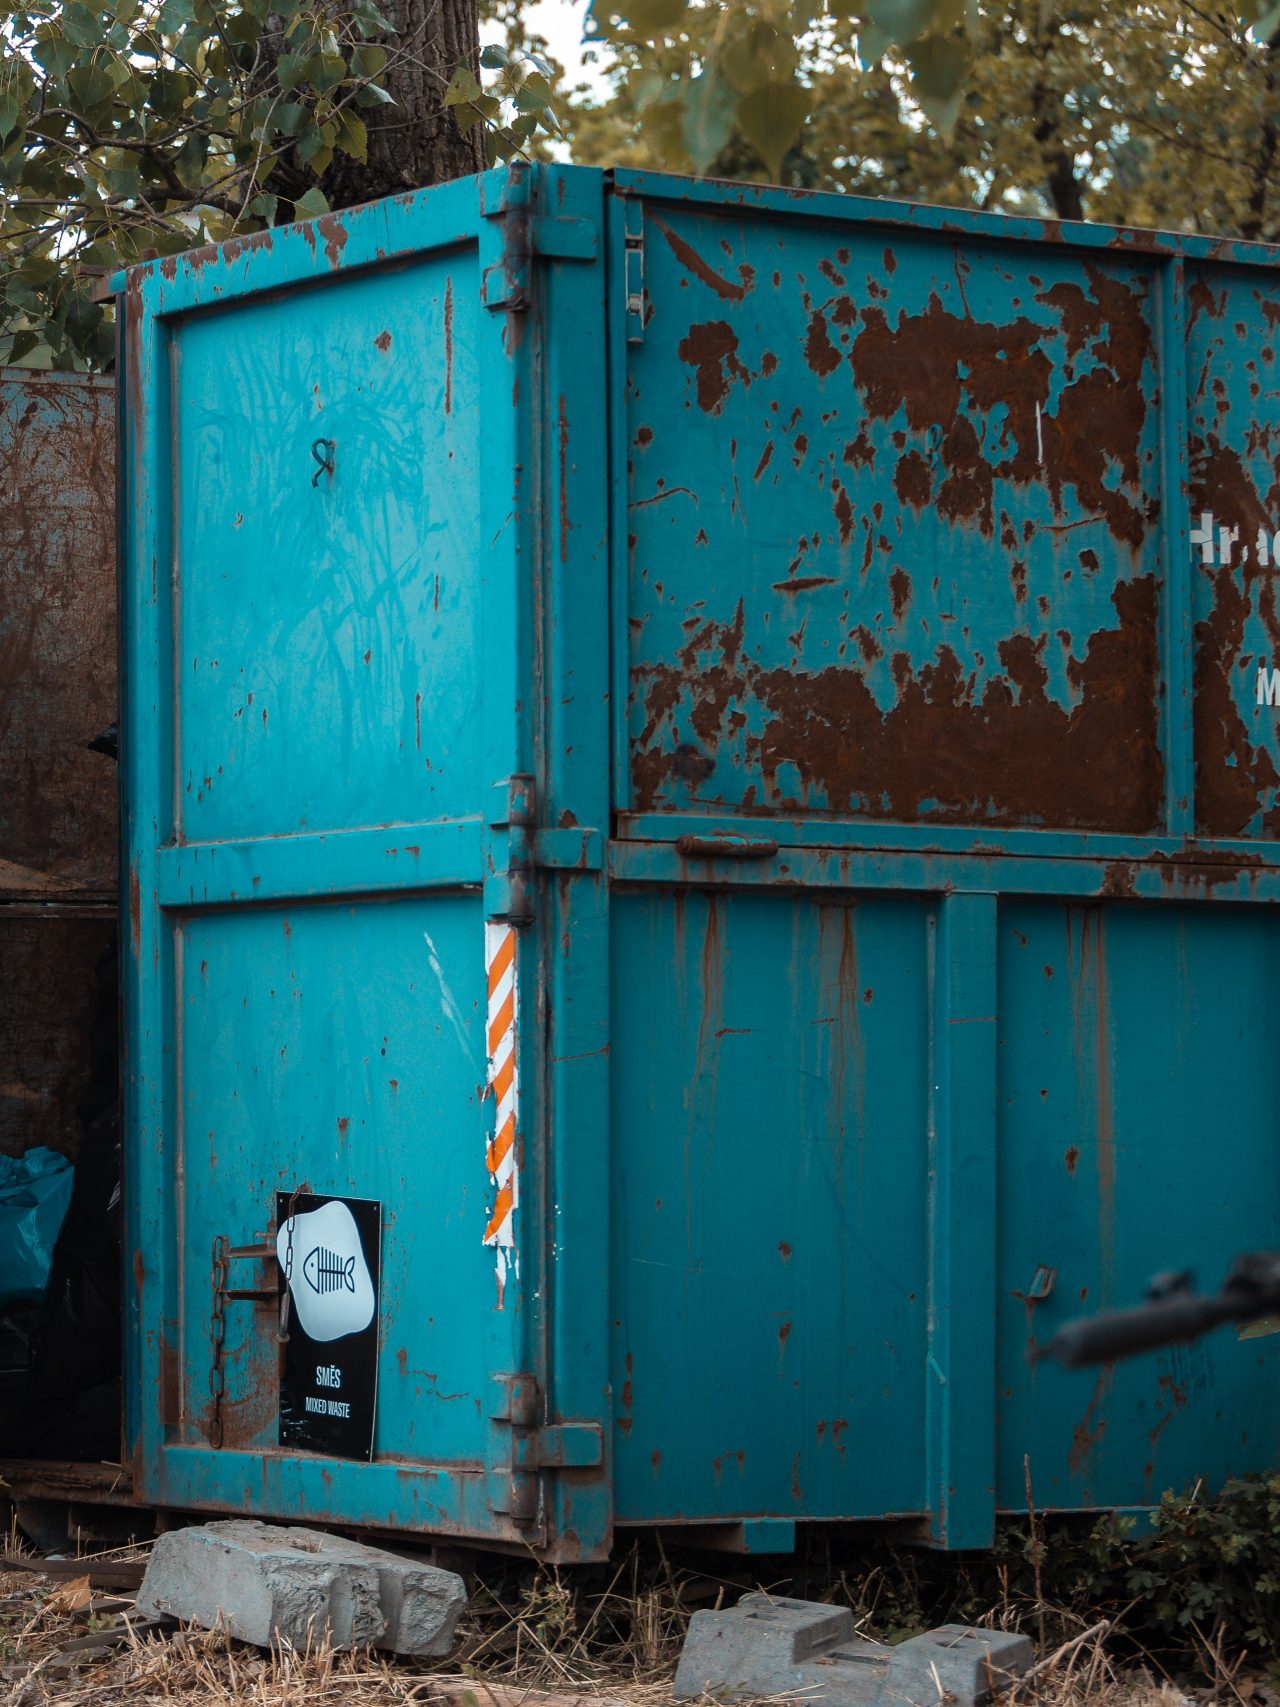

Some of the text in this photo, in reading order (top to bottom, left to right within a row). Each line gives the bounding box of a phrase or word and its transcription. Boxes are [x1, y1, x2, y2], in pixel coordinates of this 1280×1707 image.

[316, 1364, 341, 1388] SMĚS
[305, 1396, 351, 1418] MIXED WASTE
